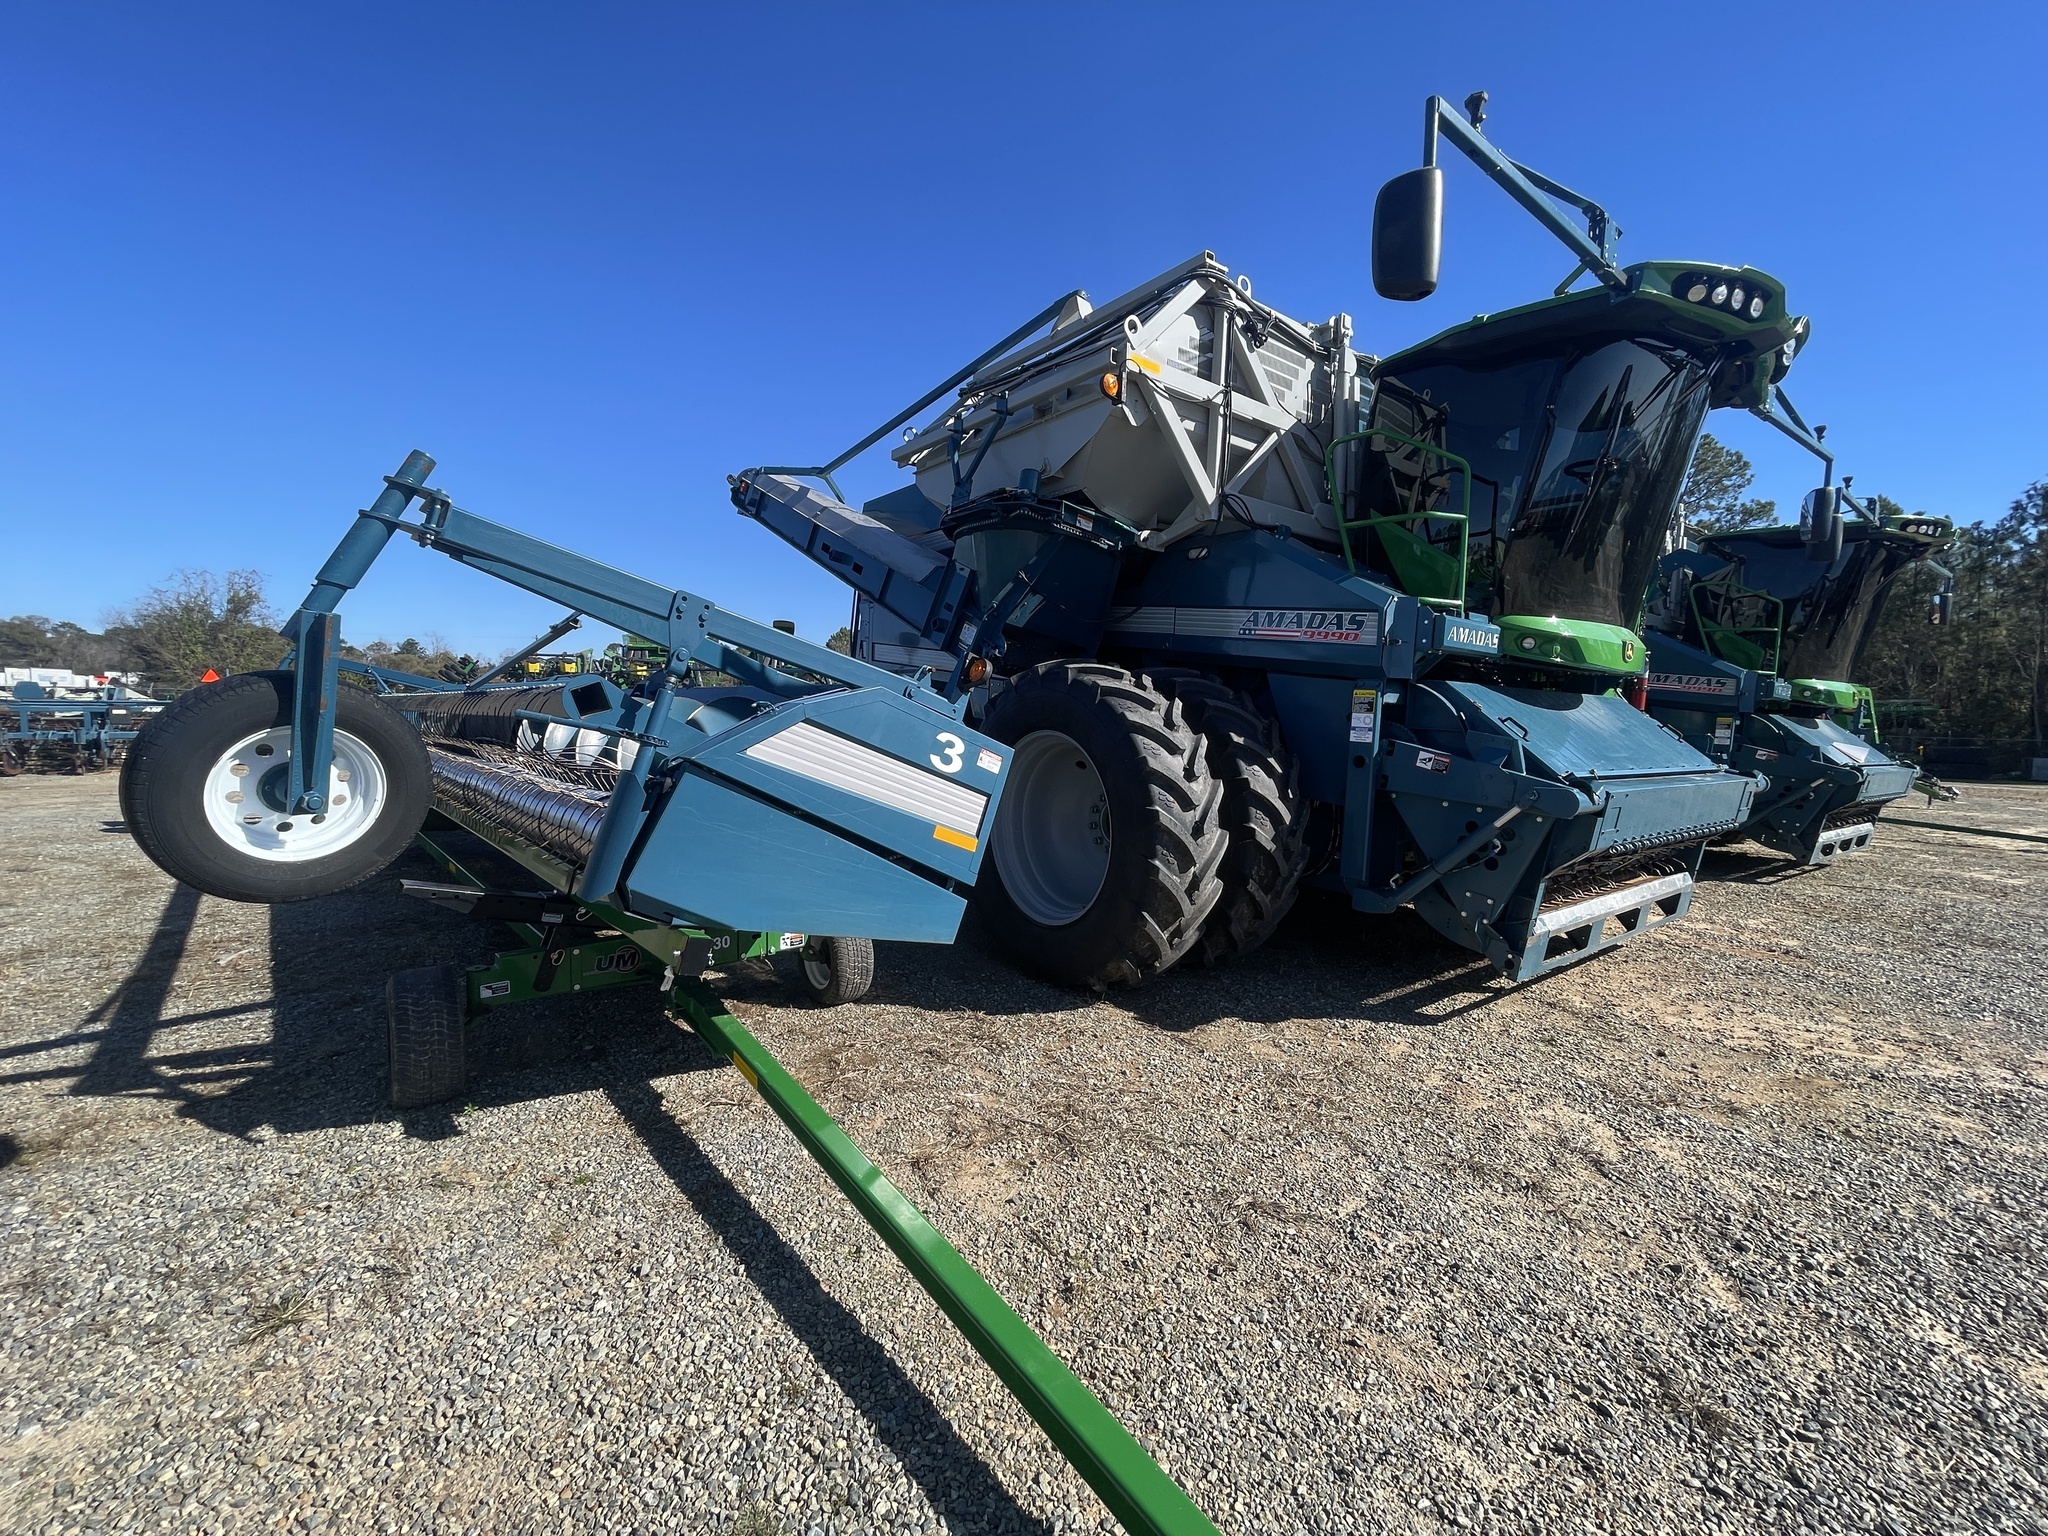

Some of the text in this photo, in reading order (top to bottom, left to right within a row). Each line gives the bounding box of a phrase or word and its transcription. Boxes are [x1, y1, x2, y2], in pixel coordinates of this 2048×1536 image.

[1241, 610, 1369, 632] AMADAS
[1302, 629, 1361, 642] 9990
[1447, 625, 1500, 649] AMADAS
[1648, 674, 1727, 688] MADAS
[929, 731, 966, 774] 3
[712, 935, 731, 950] 30
[595, 949, 639, 973] UM
